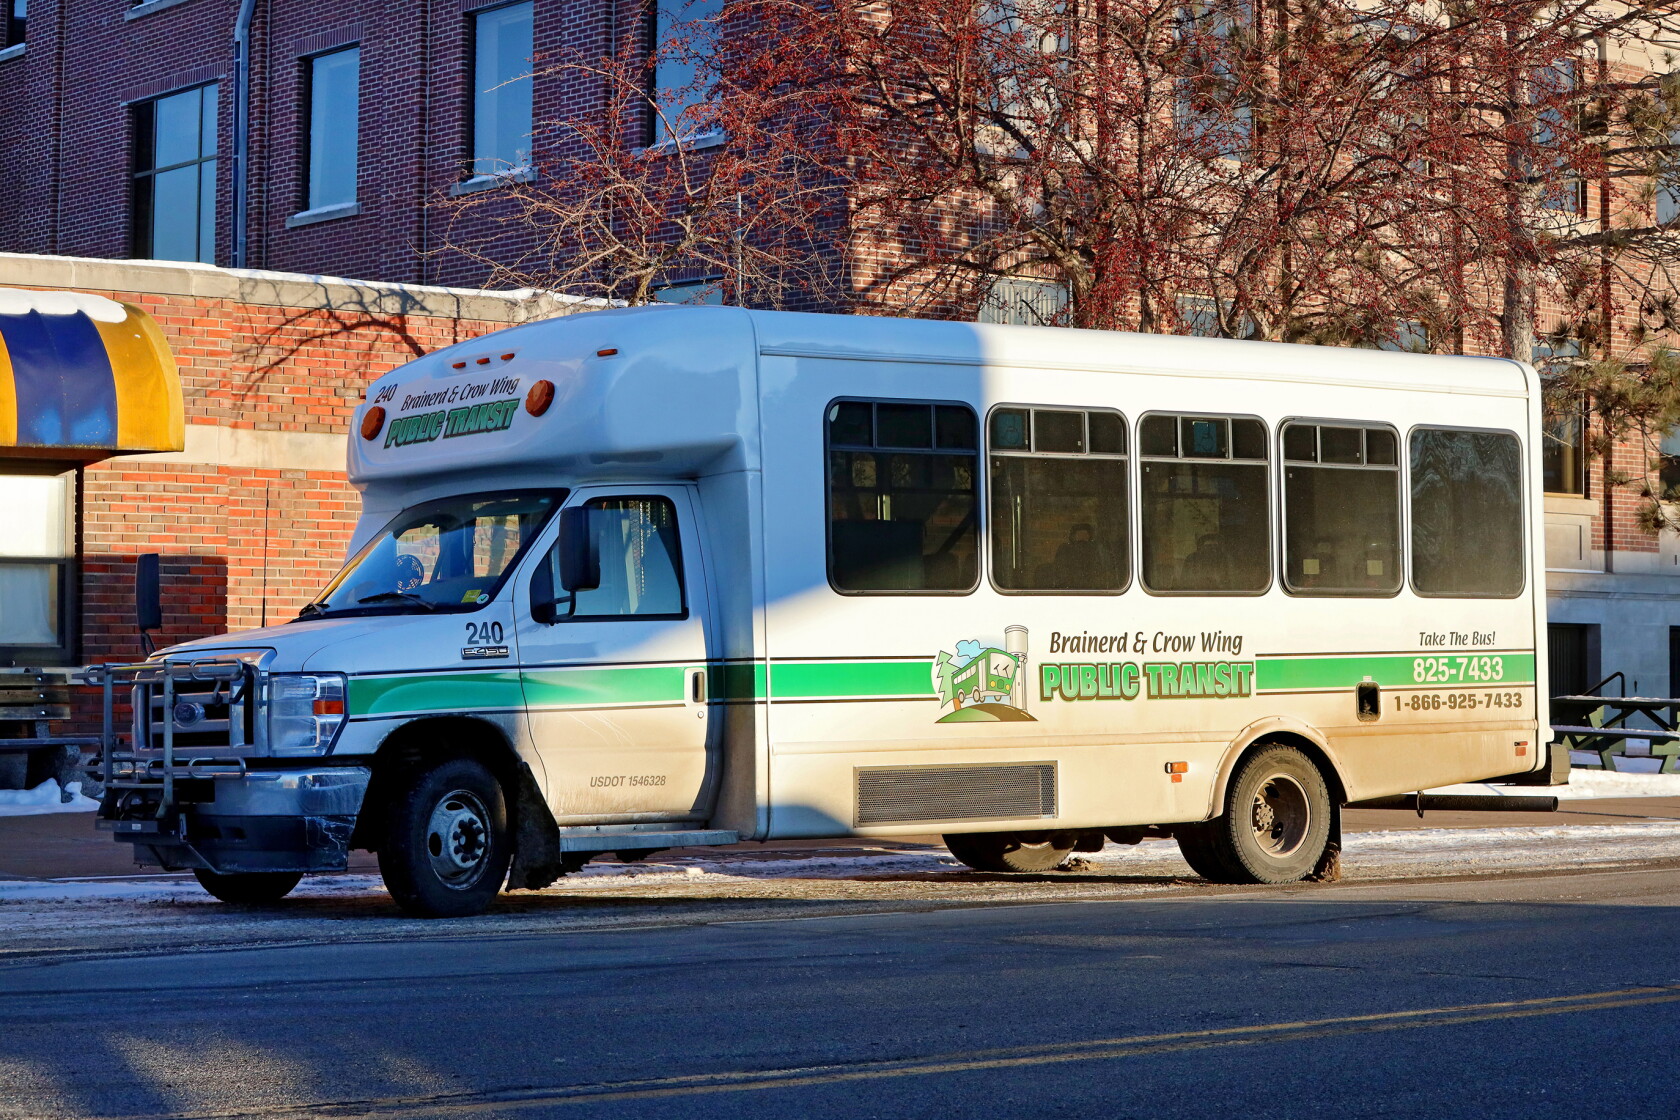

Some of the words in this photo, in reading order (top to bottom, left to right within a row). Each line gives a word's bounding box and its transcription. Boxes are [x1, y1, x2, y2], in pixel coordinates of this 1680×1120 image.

[374, 383, 398, 404] 240
[401, 386, 448, 411] Brainerd
[448, 385, 459, 403] &
[460, 383, 489, 401] Crow
[490, 376, 521, 395] Wing
[383, 410, 445, 449] PUBLIC
[443, 398, 521, 439] TRANSIT
[465, 621, 504, 644] 240
[1050, 630, 1127, 653] Brainerd
[1133, 632, 1147, 655] &
[1153, 631, 1195, 653] Crow
[1201, 631, 1243, 656] Wing
[1419, 631, 1446, 646] Take
[1449, 631, 1468, 646] The
[1472, 631, 1496, 646] Bus!
[1039, 661, 1140, 702] PUBLIC
[1143, 661, 1254, 700] TRANSIT
[1413, 656, 1504, 683] 825-7433
[1394, 692, 1523, 711] 1-866-925-7433
[590, 776, 626, 788] USDOT
[628, 775, 667, 787] 1546328
